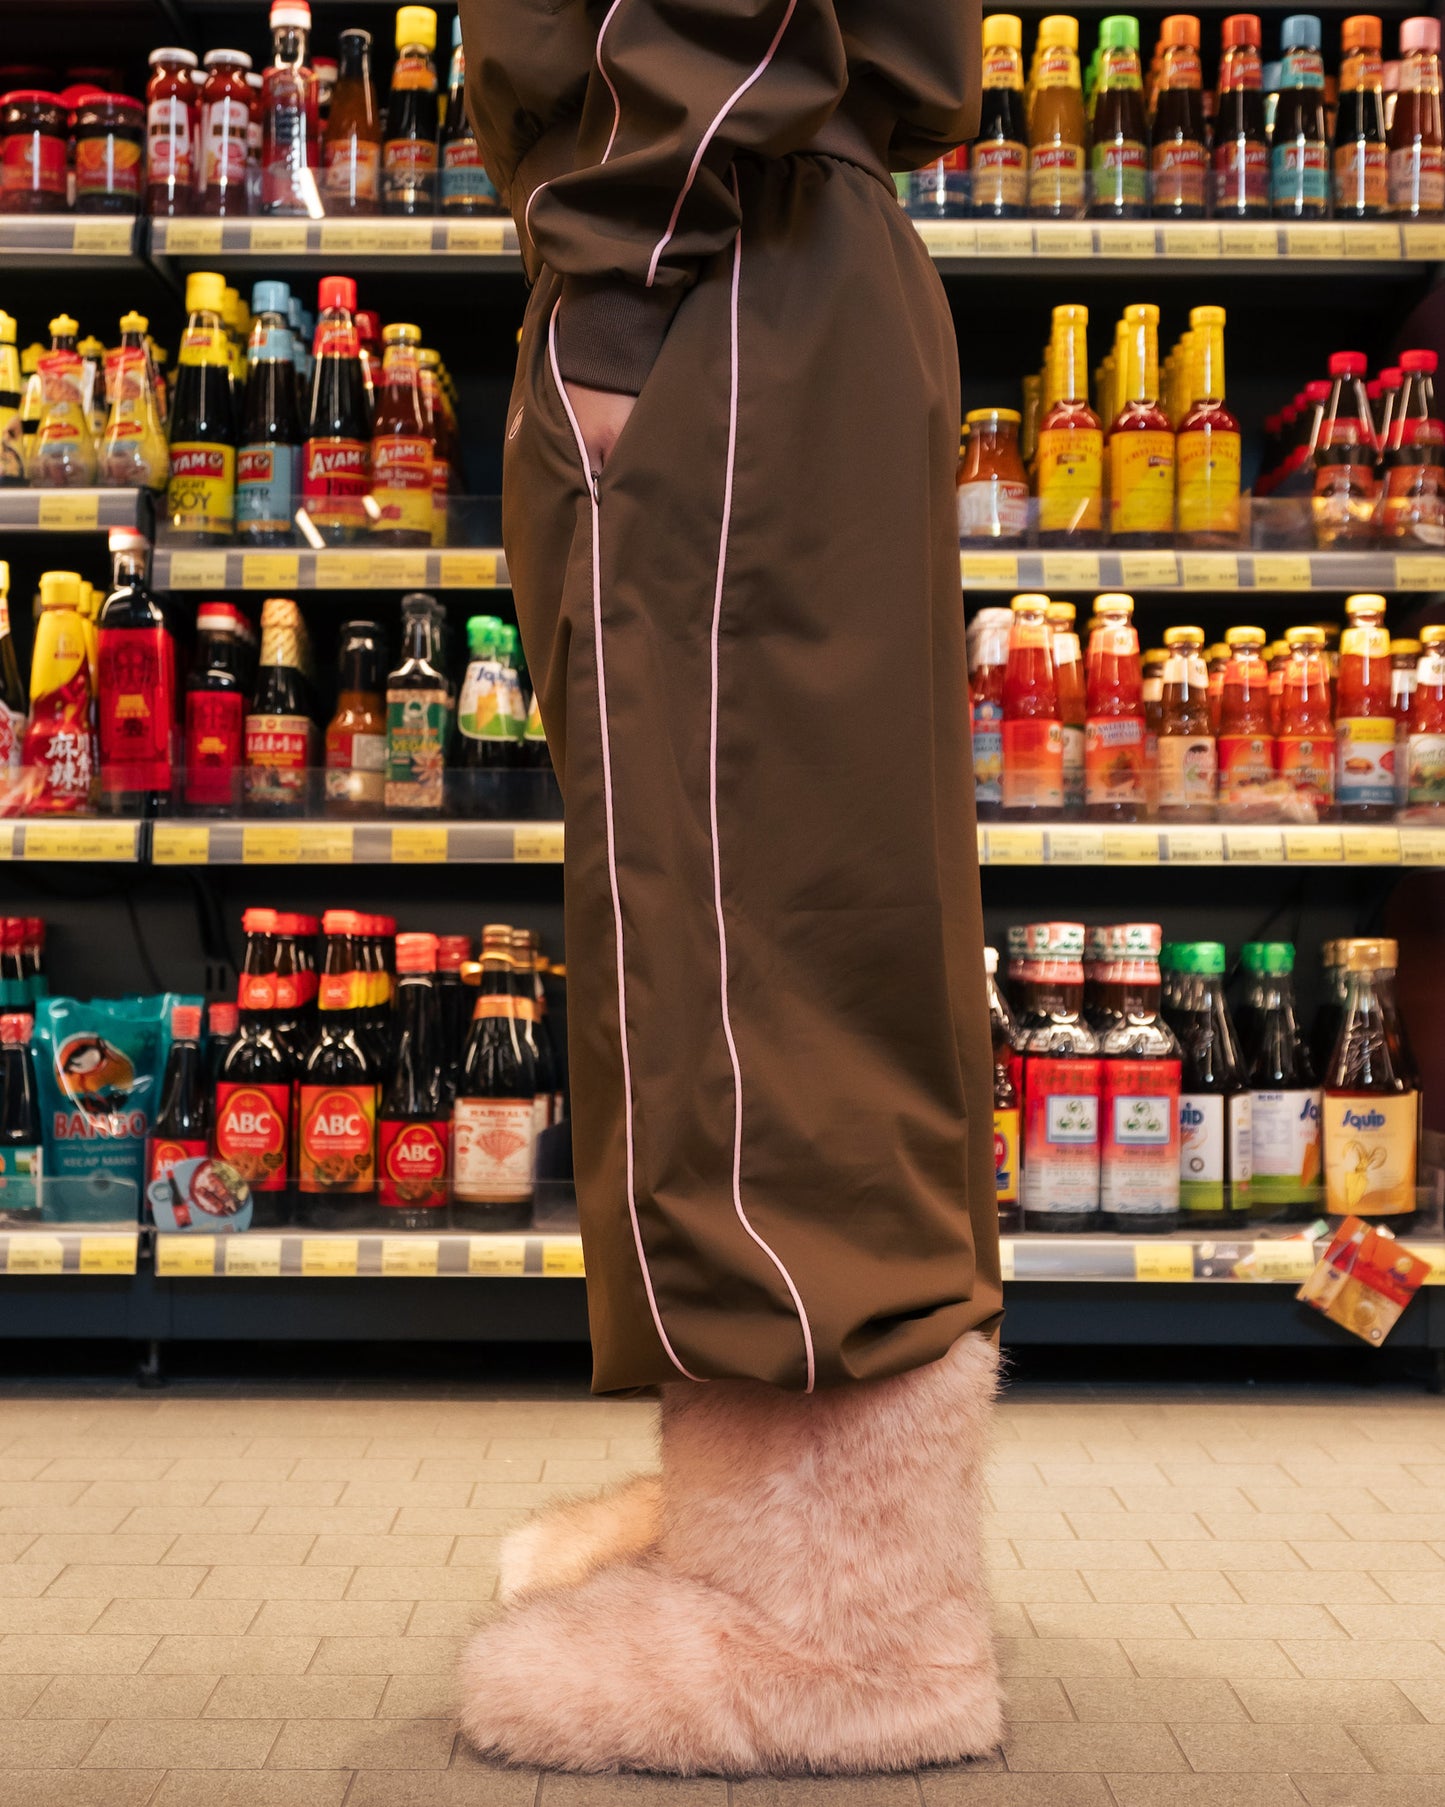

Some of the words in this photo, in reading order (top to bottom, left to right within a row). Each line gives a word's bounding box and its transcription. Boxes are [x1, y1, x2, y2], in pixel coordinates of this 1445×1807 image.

[978, 149, 1012, 171] AYAM
[1032, 150, 1065, 173] AYAM
[1161, 150, 1200, 171] AYAM
[309, 450, 361, 480] AYAM
[376, 446, 418, 468] AYAM
[54, 1110, 147, 1140] BANGO
[224, 1112, 272, 1135] ABC
[313, 1114, 361, 1136] ABC
[396, 1143, 437, 1162] ABC
